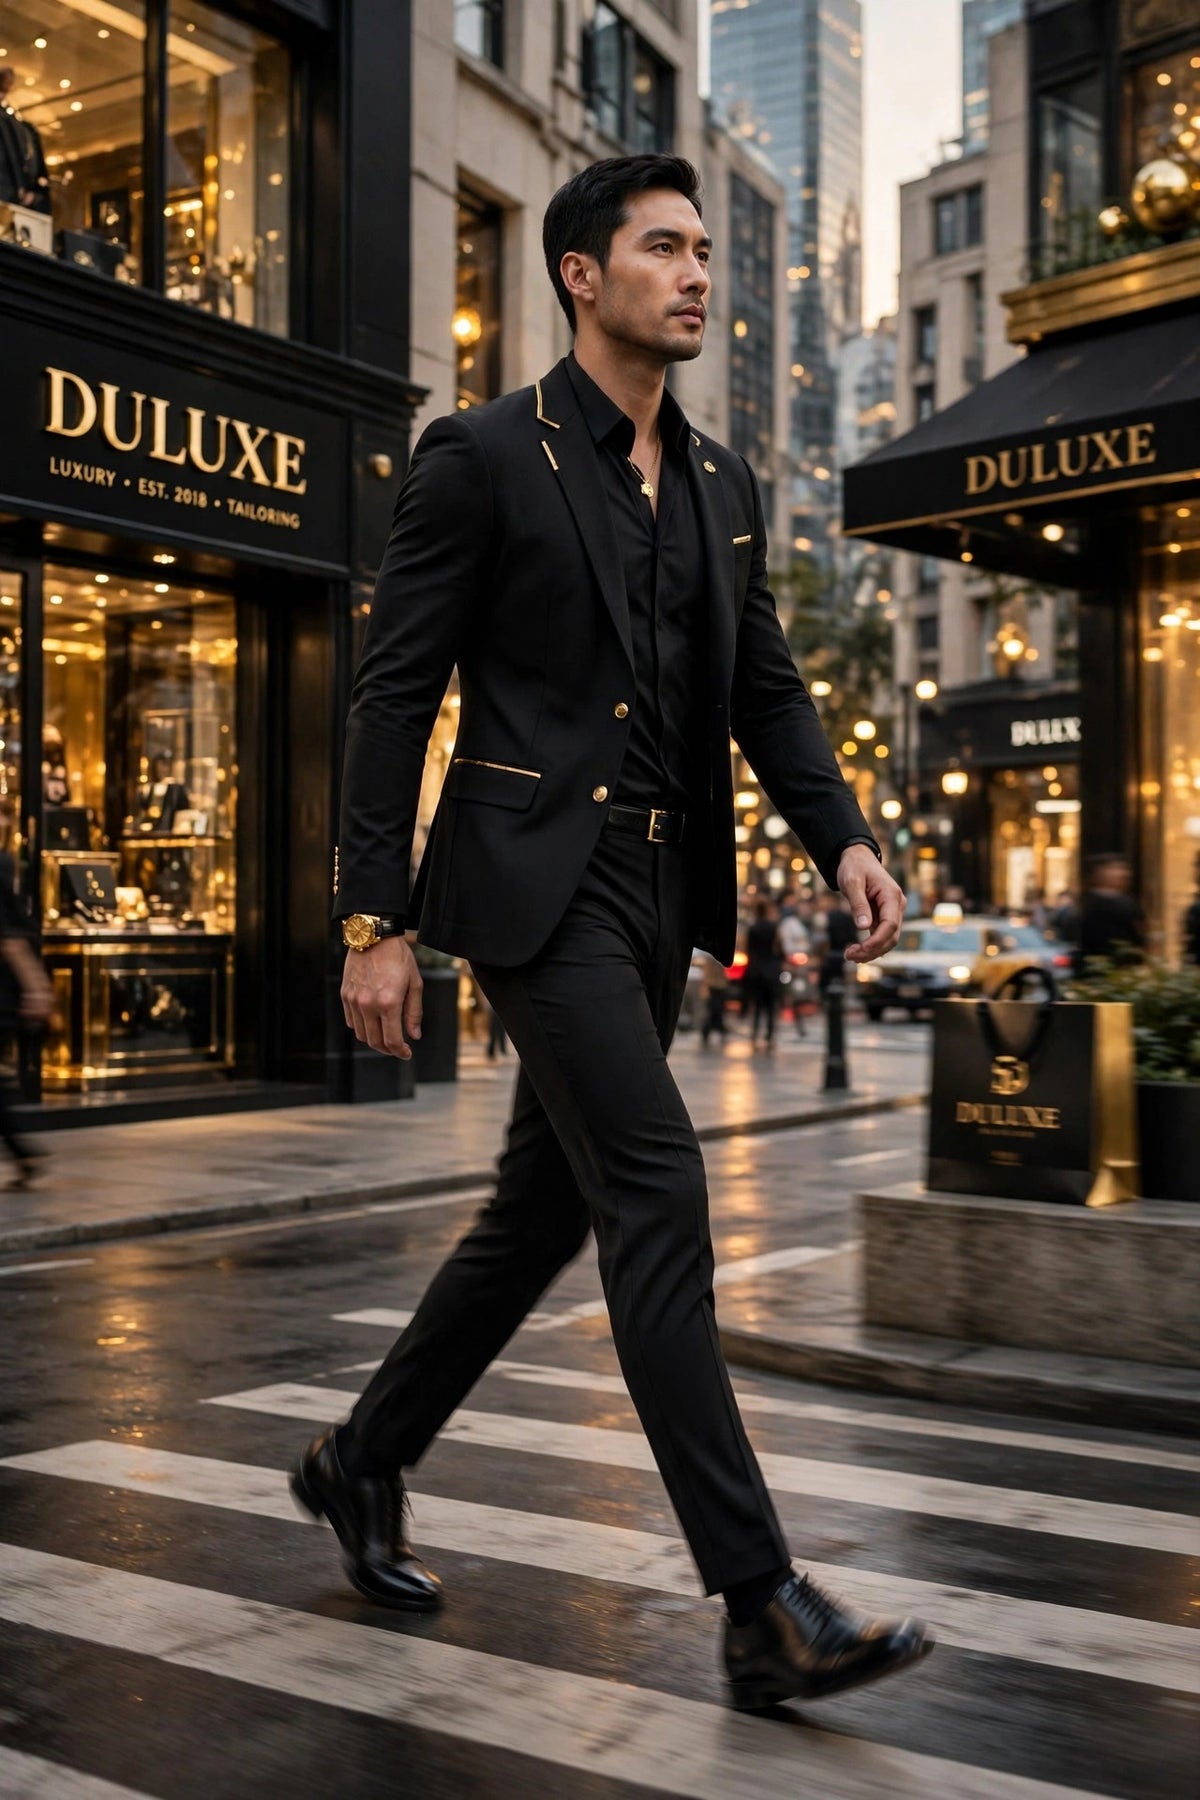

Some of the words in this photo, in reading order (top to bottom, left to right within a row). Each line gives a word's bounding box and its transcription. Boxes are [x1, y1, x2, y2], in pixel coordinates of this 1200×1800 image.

[45, 366, 307, 495] DULUXE
[964, 422, 1156, 495] DULUXE
[49, 456, 116, 488] LUXURY
[138, 478, 169, 500] EST.
[226, 498, 300, 530] TAILORING
